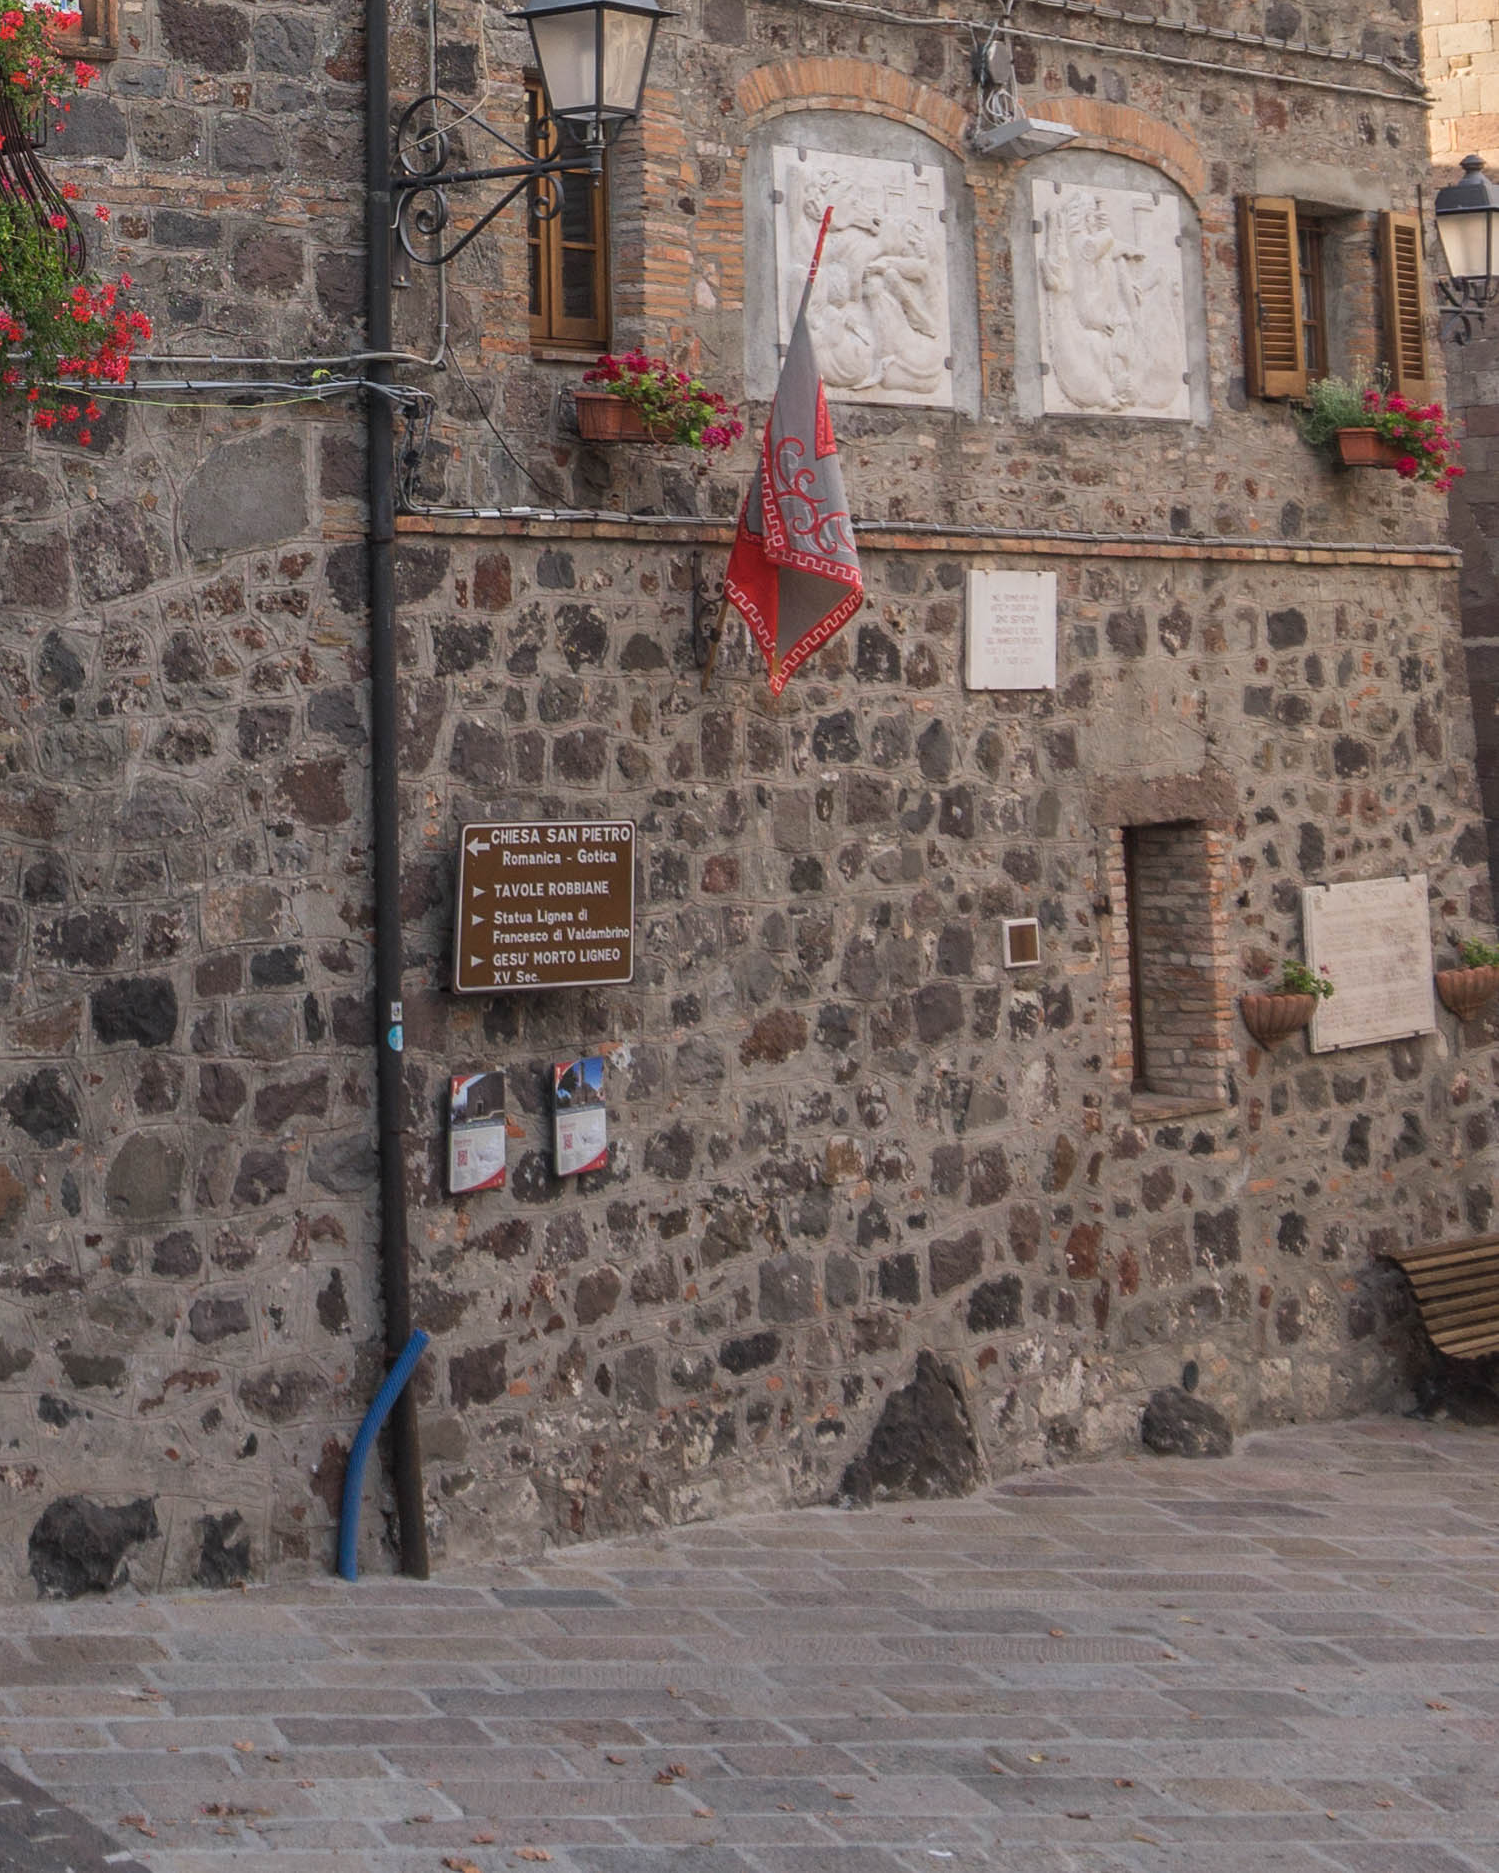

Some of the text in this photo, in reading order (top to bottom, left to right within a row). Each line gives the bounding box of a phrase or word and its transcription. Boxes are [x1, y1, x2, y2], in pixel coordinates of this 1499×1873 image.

[490, 827, 630, 844] CHIESA SAN PIETRO
[502, 850, 561, 865] Romanica
[577, 849, 617, 863] Gotica
[494, 881, 609, 897] TAVOLE ROBBIANE
[494, 908, 588, 924] Statua Lignea di
[493, 927, 630, 943] Francesco di Valdambrino
[493, 948, 620, 966] GESU' MORTO LIGNEO
[493, 971, 540, 984] XV Sec.
